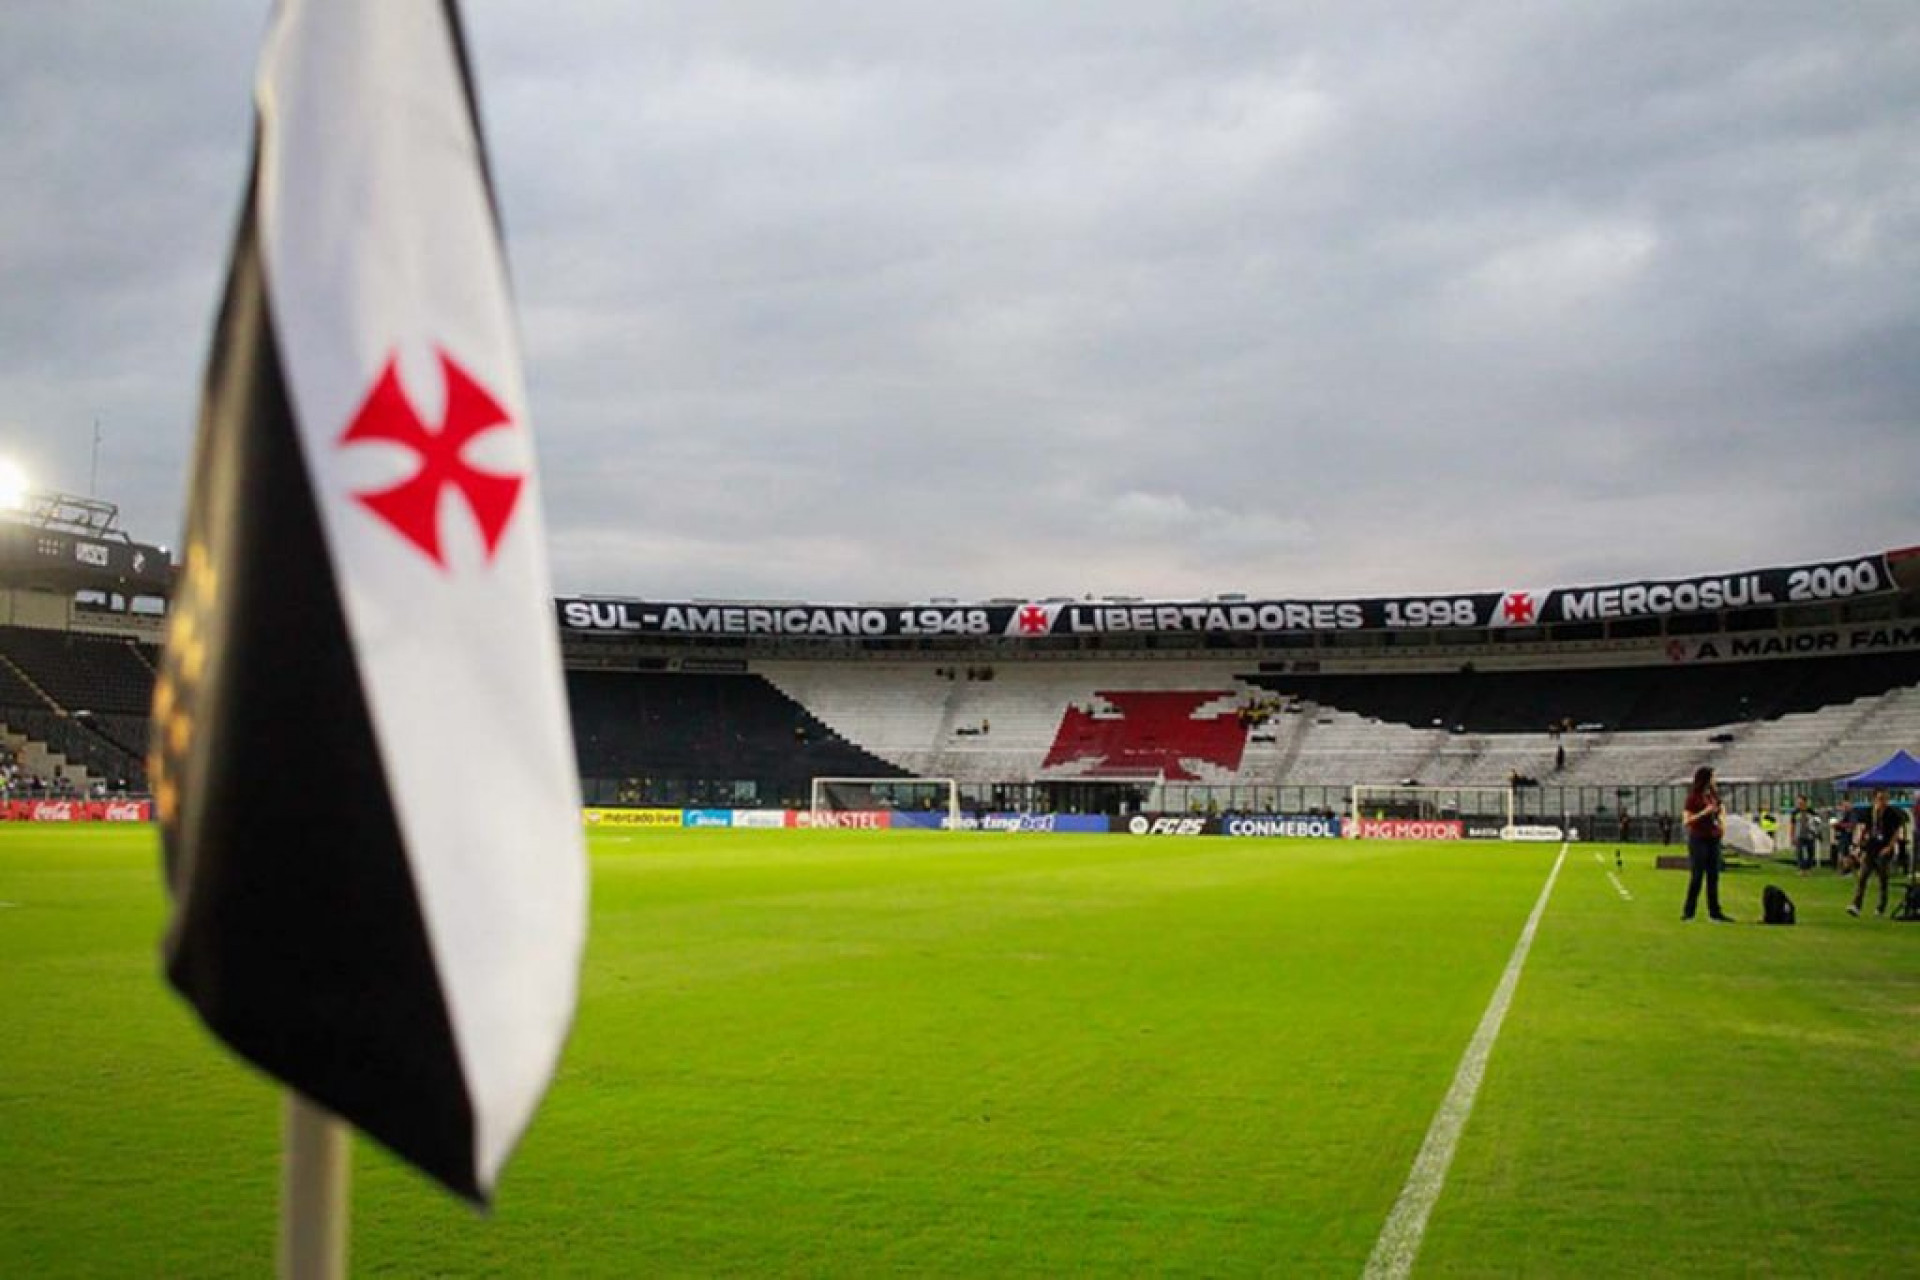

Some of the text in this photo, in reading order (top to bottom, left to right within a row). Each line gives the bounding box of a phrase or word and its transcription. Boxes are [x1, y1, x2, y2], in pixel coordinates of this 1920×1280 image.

[1561, 561, 1879, 620] MERCOSUL 2000
[565, 602, 990, 634] SUL-AMERICANO 1948
[1070, 600, 1476, 632] LIBERTADORES 1998
[1696, 641, 1721, 661] A
[1731, 630, 1840, 657] MAIOR
[1229, 820, 1335, 837] CONMEBOL
[1399, 822, 1458, 839] MOTOR
